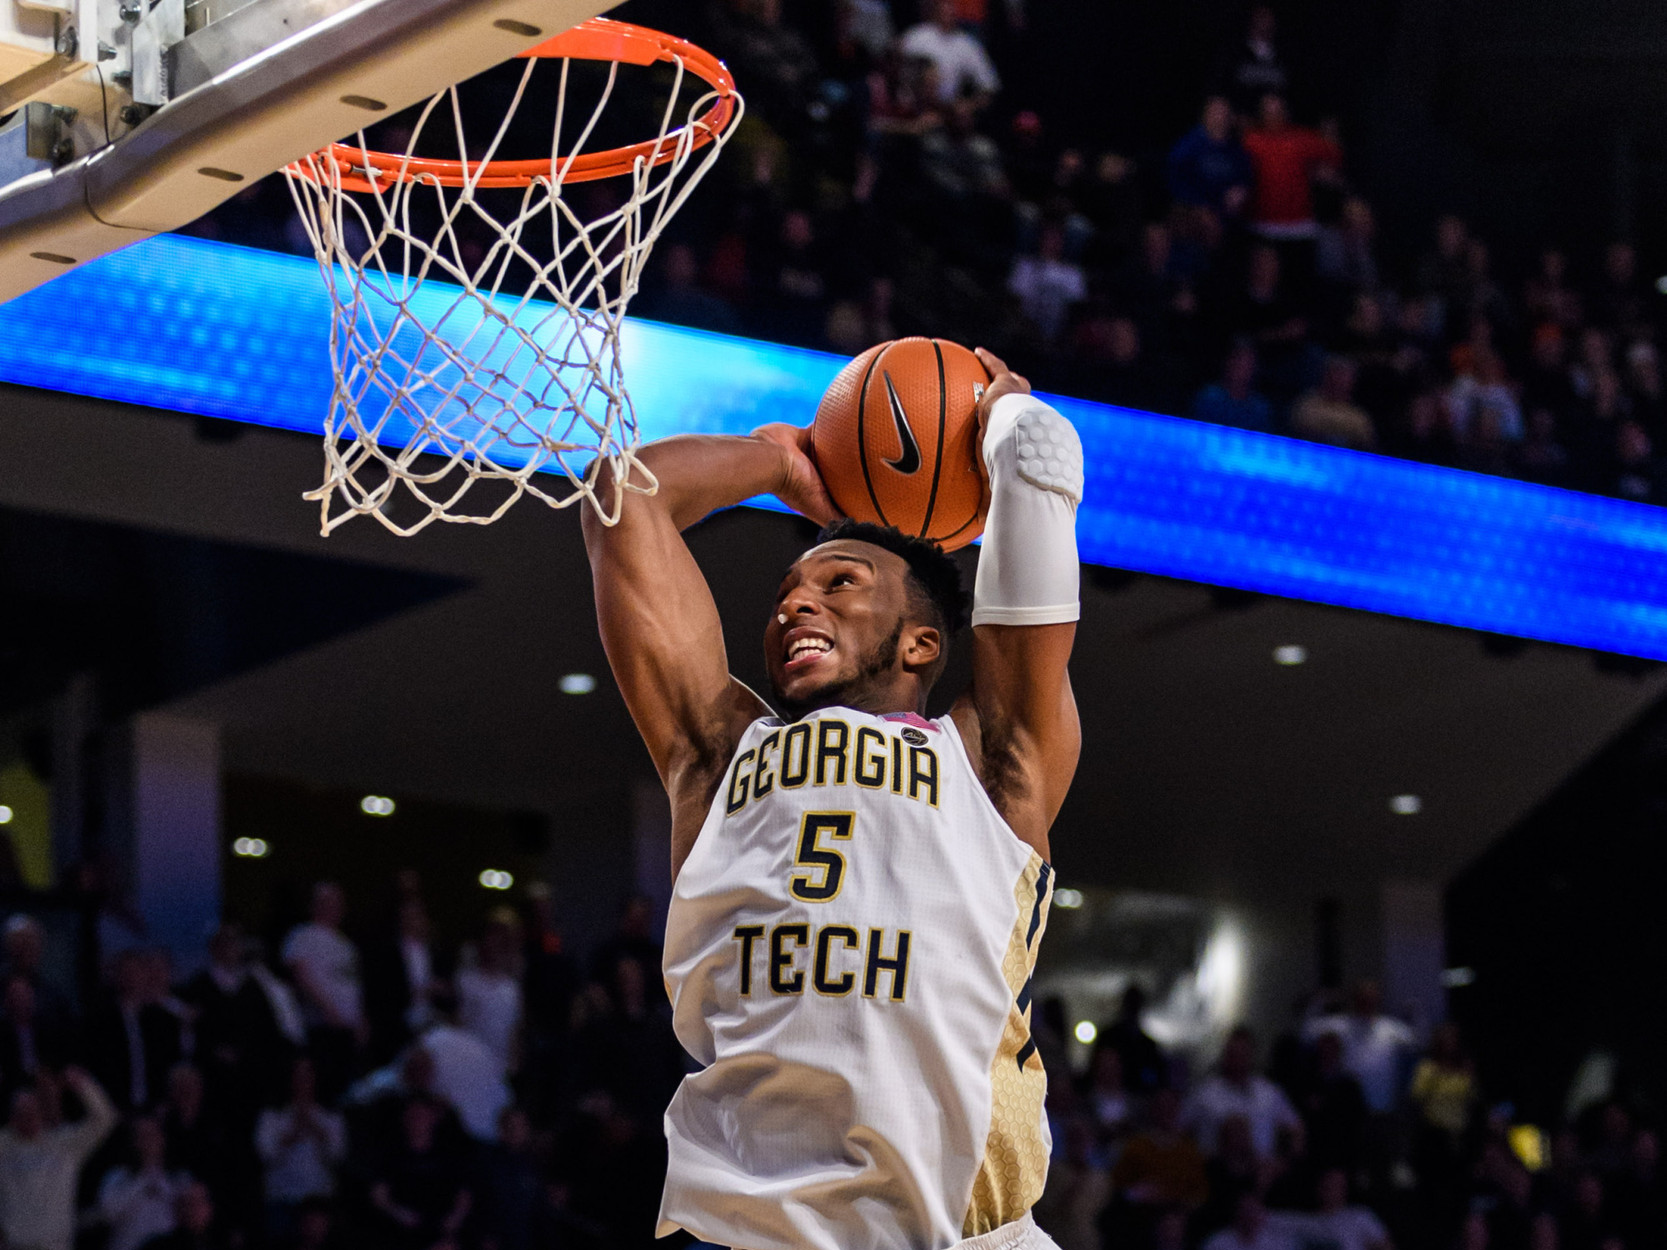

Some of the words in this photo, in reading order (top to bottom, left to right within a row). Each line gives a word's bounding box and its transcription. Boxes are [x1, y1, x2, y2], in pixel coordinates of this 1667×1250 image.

[726, 719, 940, 818] GEORGIA
[789, 811, 856, 903] 5
[733, 923, 912, 1003] TECH
